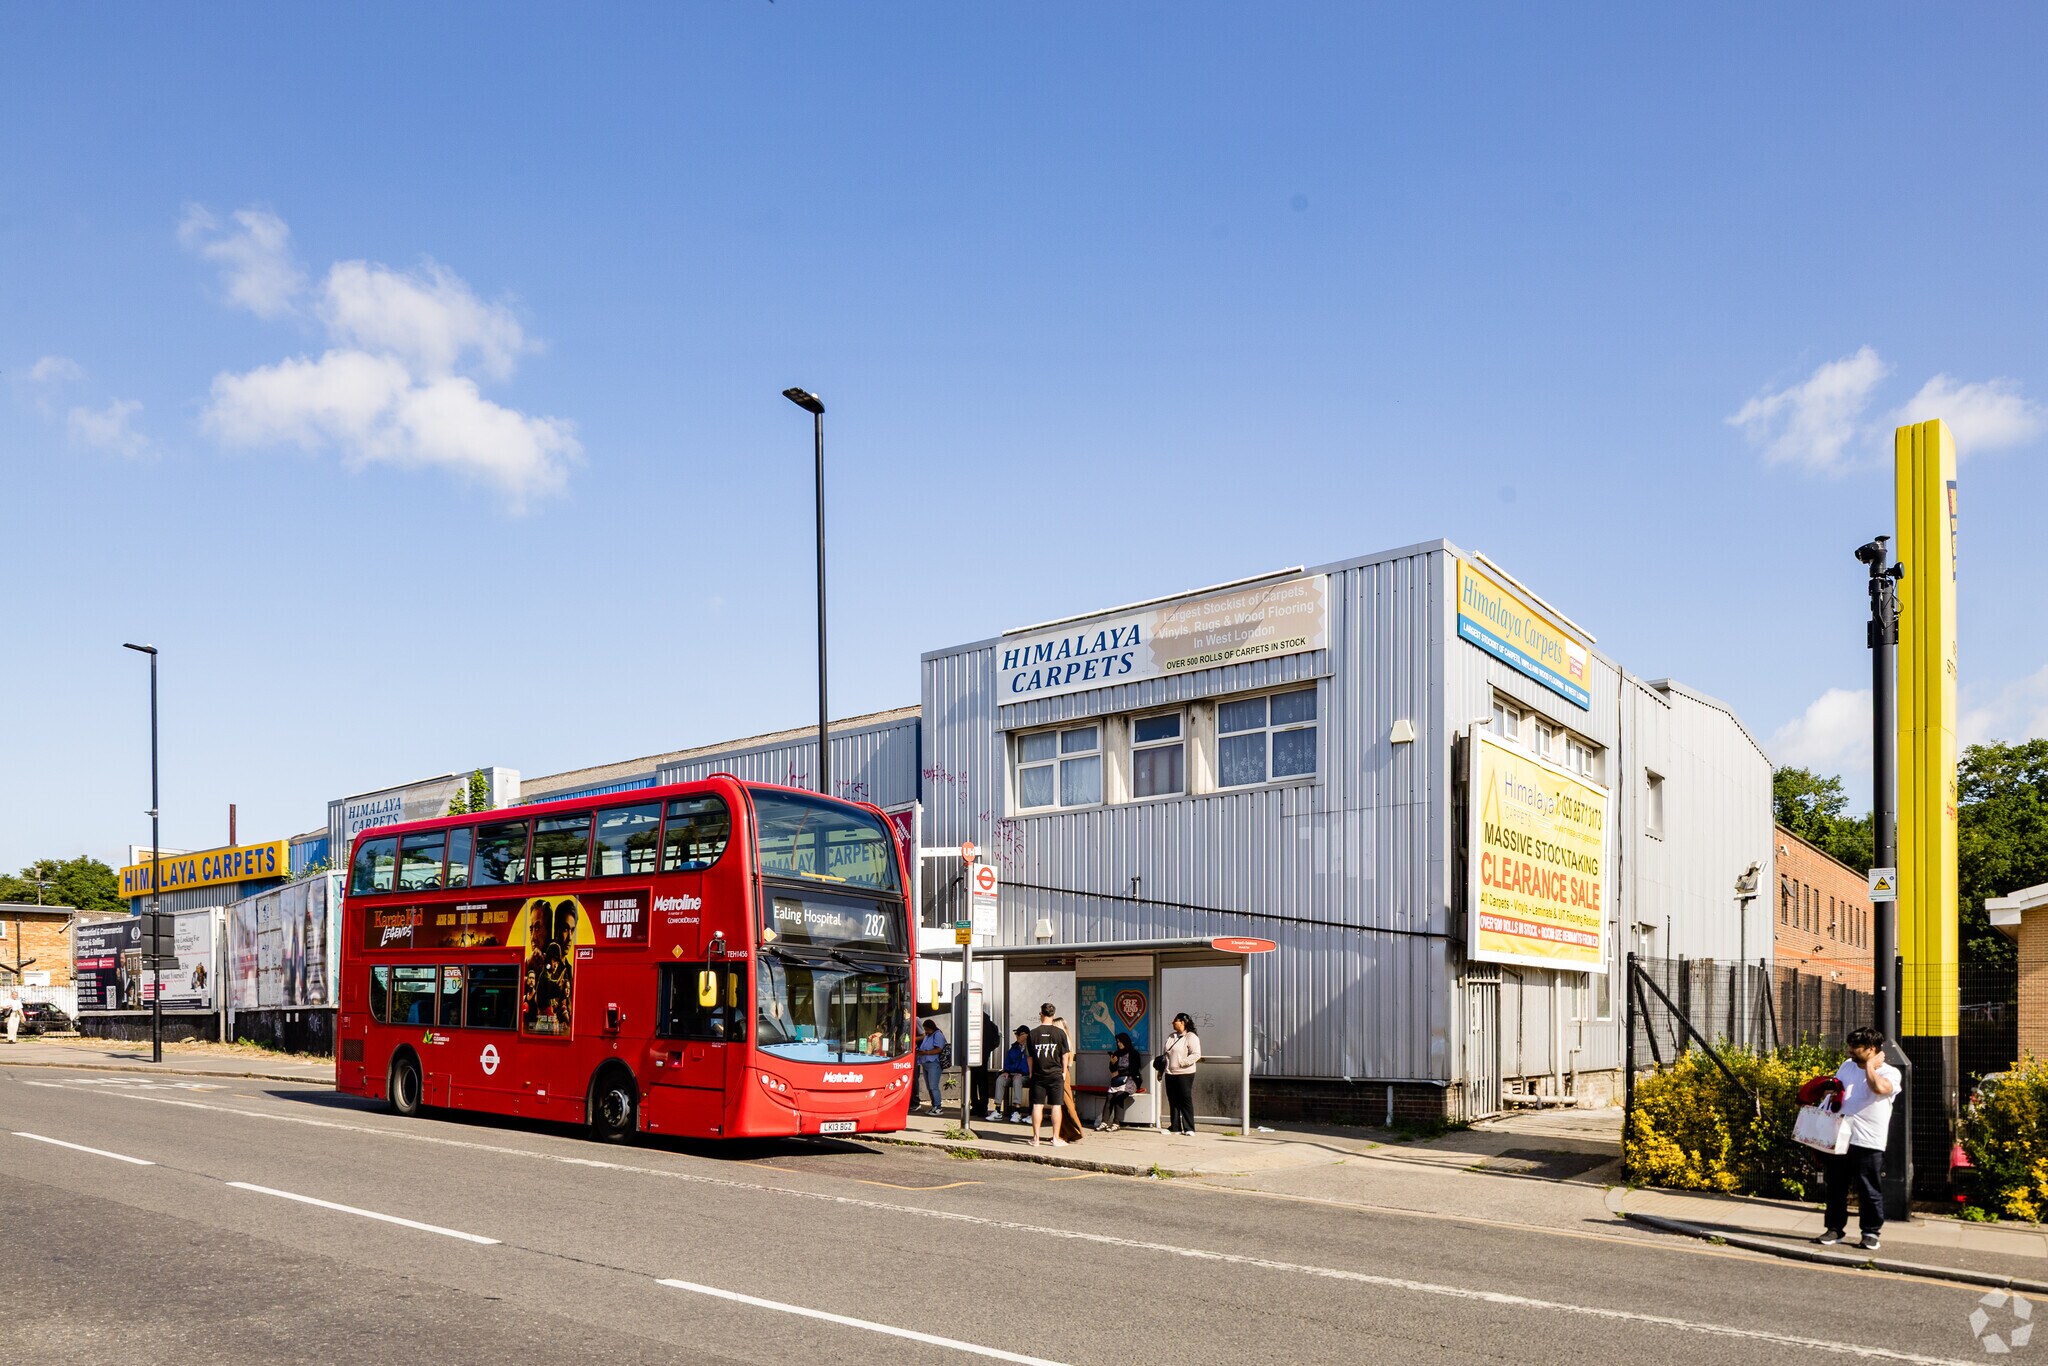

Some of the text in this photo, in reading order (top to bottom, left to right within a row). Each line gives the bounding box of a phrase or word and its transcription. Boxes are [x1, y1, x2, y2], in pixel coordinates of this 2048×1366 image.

[1164, 585, 1308, 622] Largest Stockist of Carpets,
[1159, 602, 1314, 639] Vinyls, Rugs & Wood Flooring
[1463, 575, 1563, 664] Himalaya Carpets
[1002, 624, 1141, 671] HIMALAYA
[1193, 625, 1275, 648] In West London
[1166, 637, 1306, 670] OVER 500 ROLLS OF CARPETS IN STOCK
[1011, 652, 1134, 693] CARPETS
[1504, 771, 1554, 816] Himalaya
[348, 797, 401, 819] HIMALAYA
[963, 847, 975, 857] UH
[1484, 822, 1598, 876] MASSIVE STOCKTAKING
[124, 846, 275, 892] HIMLAYA CARPETS
[1481, 851, 1600, 911] CLEARANCE SALE
[653, 894, 702, 911] Metroline
[1489, 894, 1509, 910] Carpets
[373, 908, 423, 928] Karate Kid
[600, 908, 640, 924] WEDNESDAY
[774, 906, 886, 937] Ealing Hospital 282
[380, 925, 412, 947] LEGENDS
[606, 924, 632, 938] MAY 28
[727, 950, 748, 958] TEH1456
[1122, 999, 1138, 1007] BE
[1123, 1006, 1138, 1014] KIND
[1035, 1043, 1057, 1058] 777
[823, 1071, 864, 1083] Metroline
[892, 1062, 912, 1070] TEH1456
[824, 1122, 852, 1131] LK13 BGZ
